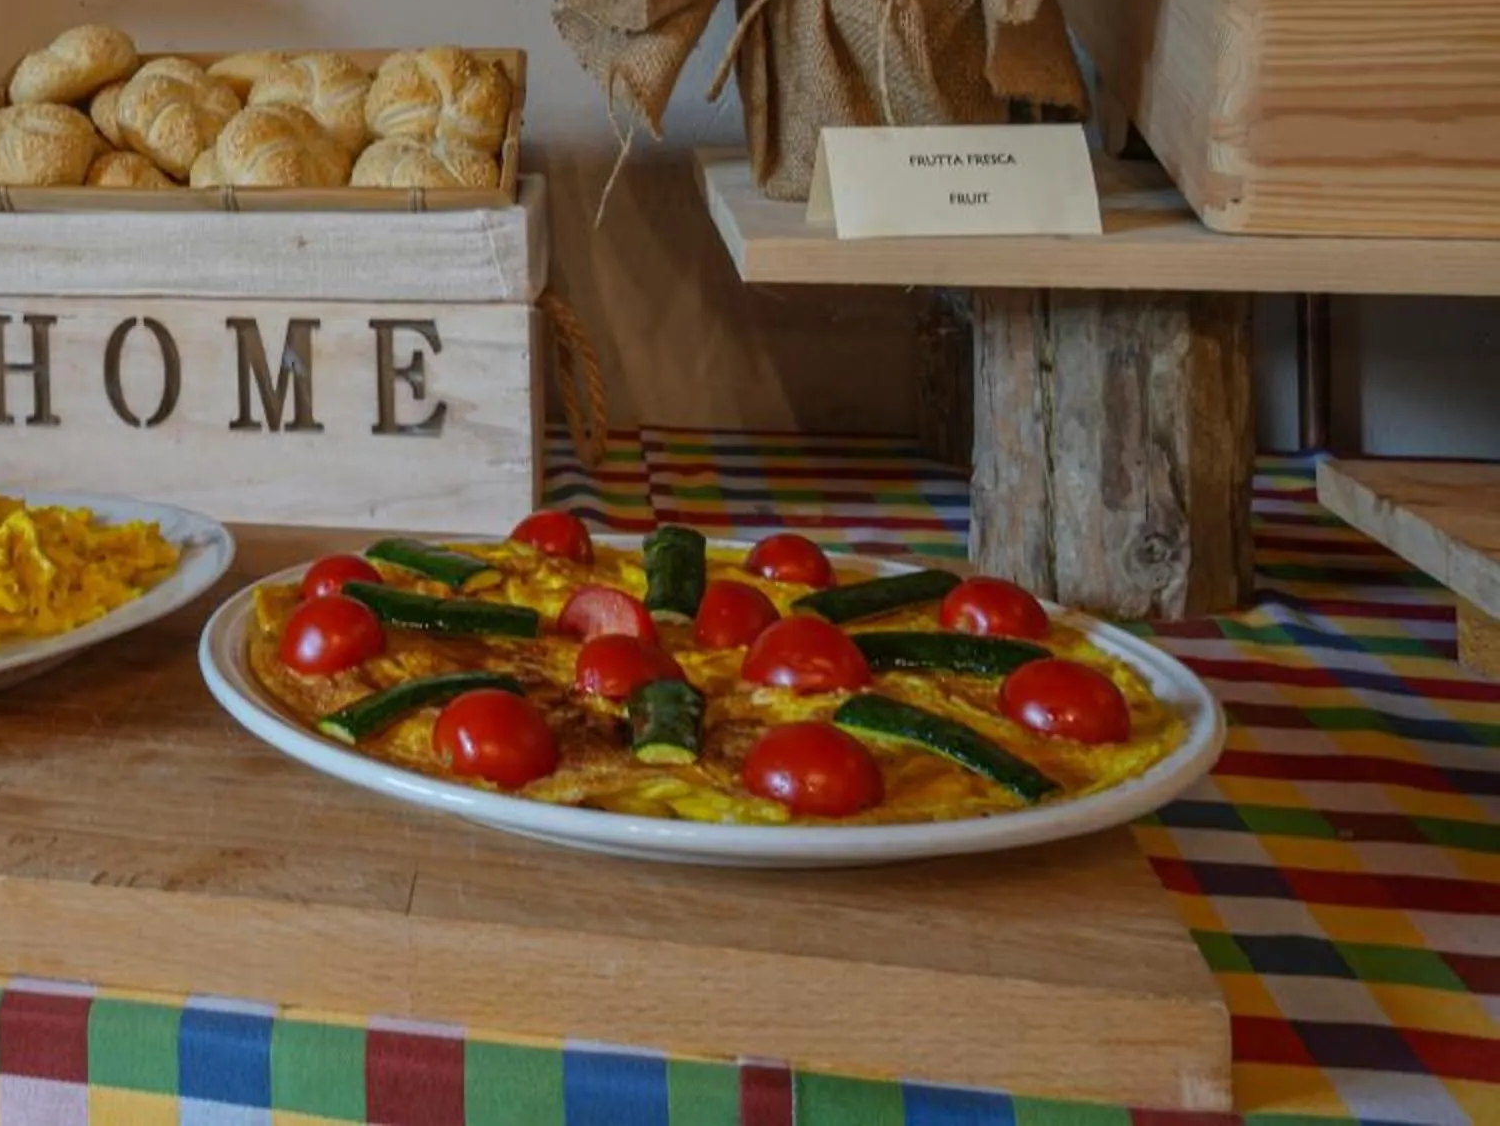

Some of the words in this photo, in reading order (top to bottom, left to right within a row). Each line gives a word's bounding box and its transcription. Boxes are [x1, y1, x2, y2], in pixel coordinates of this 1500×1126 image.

[908, 153, 963, 167] FRUTTA
[966, 153, 1016, 166] FRESCA
[949, 192, 989, 205] FRUIT
